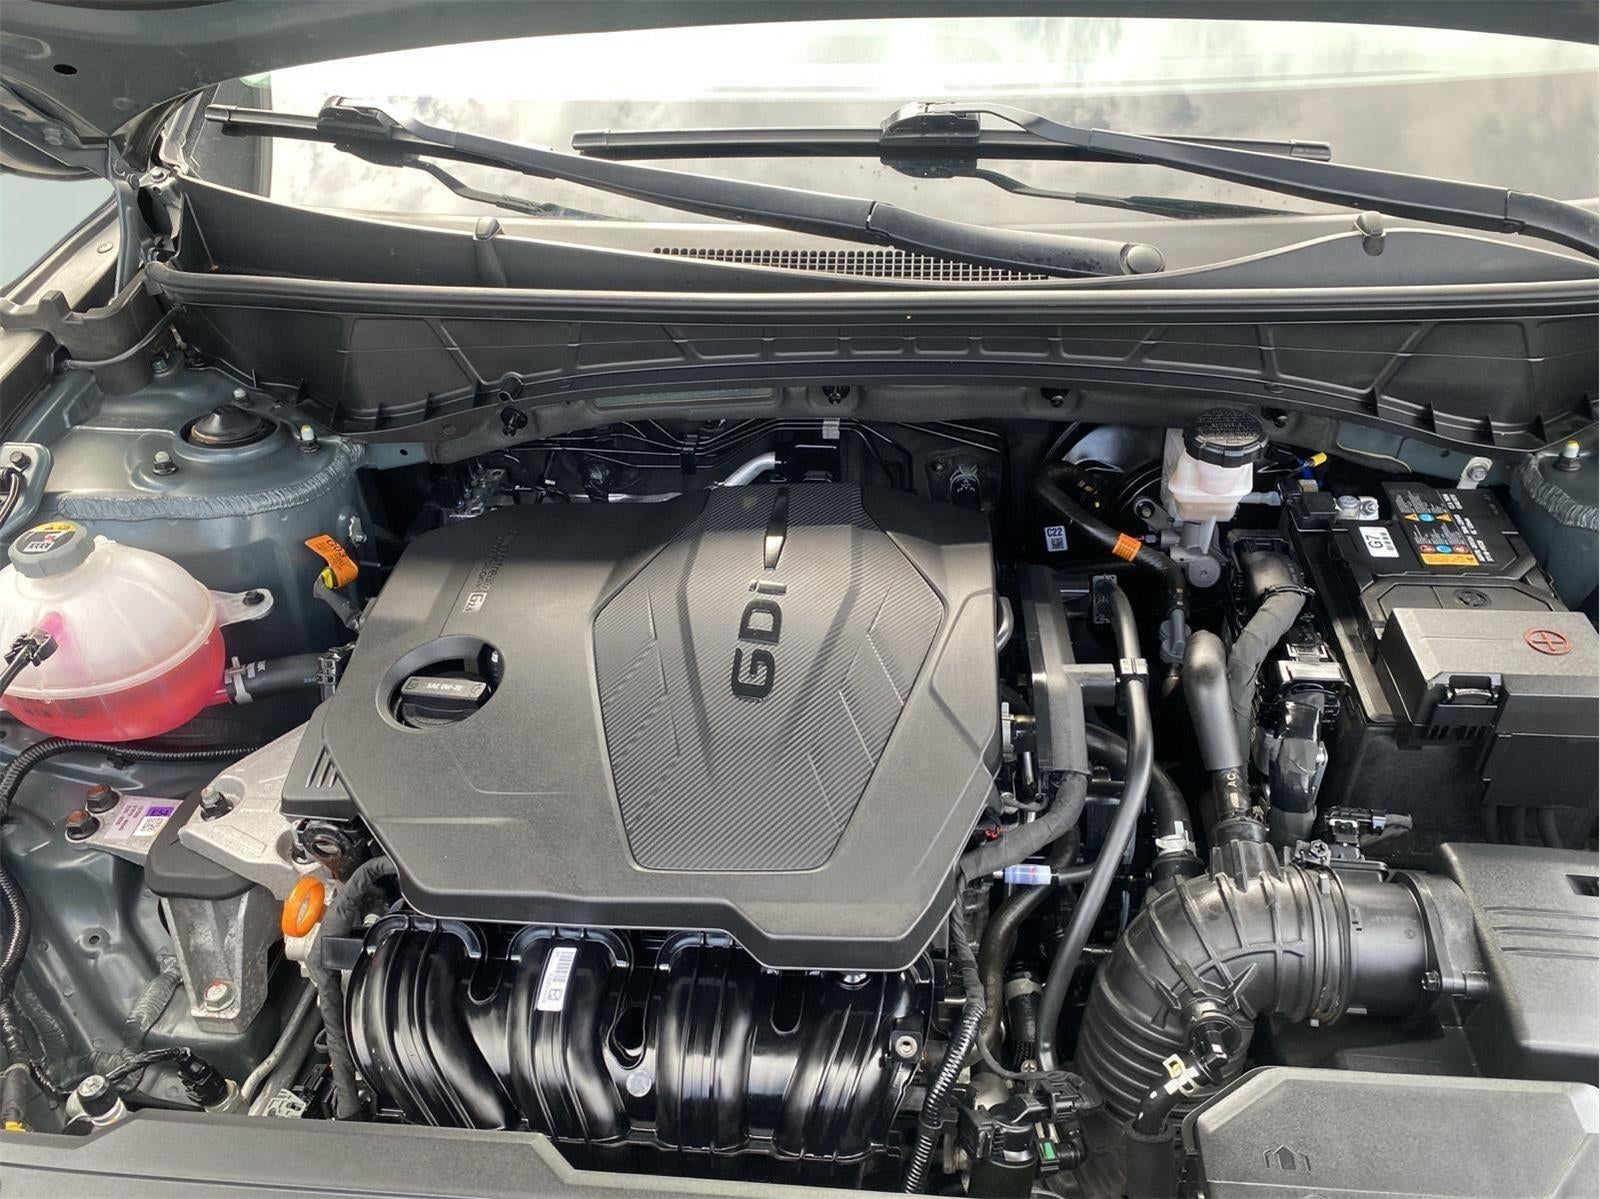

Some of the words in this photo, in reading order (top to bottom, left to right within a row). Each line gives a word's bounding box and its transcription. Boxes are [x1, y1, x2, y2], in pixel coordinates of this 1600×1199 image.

[1046, 527, 1063, 537] C22
[1365, 534, 1383, 548] G7
[731, 579, 787, 700] GDi
